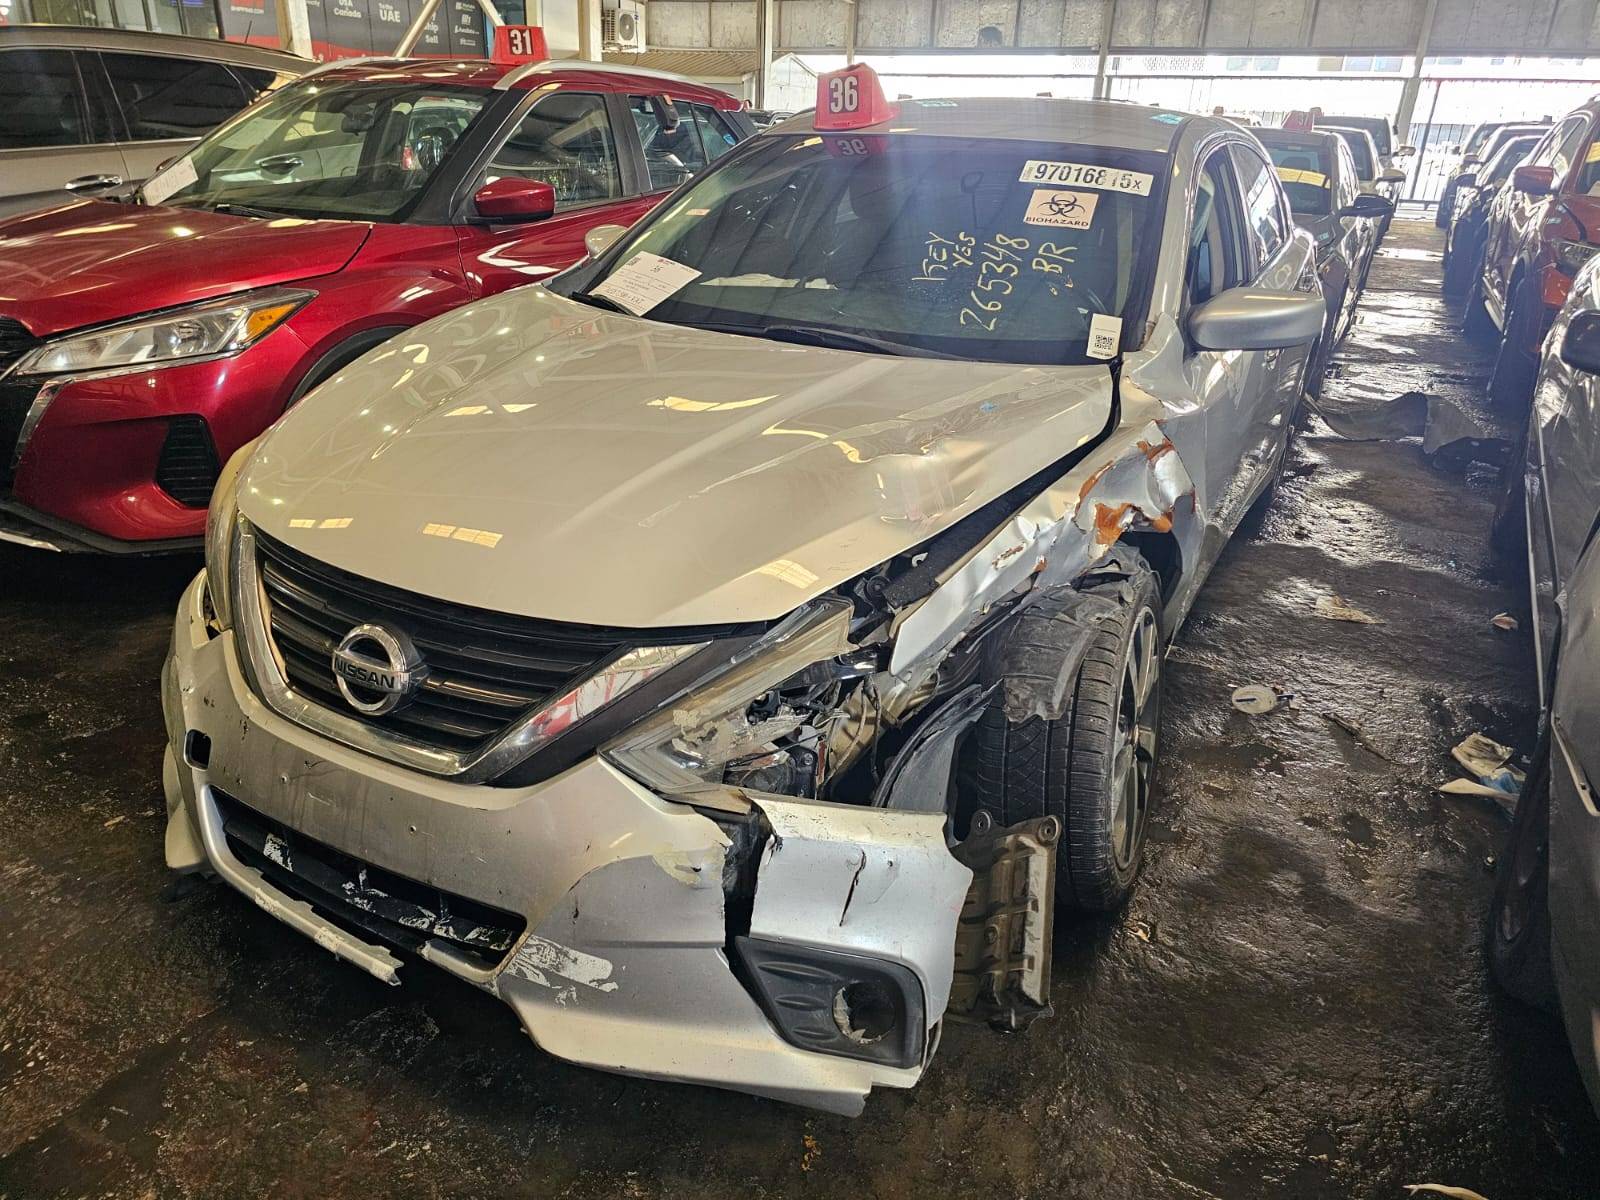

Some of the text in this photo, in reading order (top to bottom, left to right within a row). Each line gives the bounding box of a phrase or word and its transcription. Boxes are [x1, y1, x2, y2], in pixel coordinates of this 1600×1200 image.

[333, 7, 362, 18] Canada
[379, 9, 401, 23] UAE
[510, 29, 532, 55] 31
[830, 76, 857, 112] 36
[1026, 216, 1089, 228] BIOHAZARD
[1032, 243, 1078, 274] BR
[335, 660, 395, 689] NISSAN
